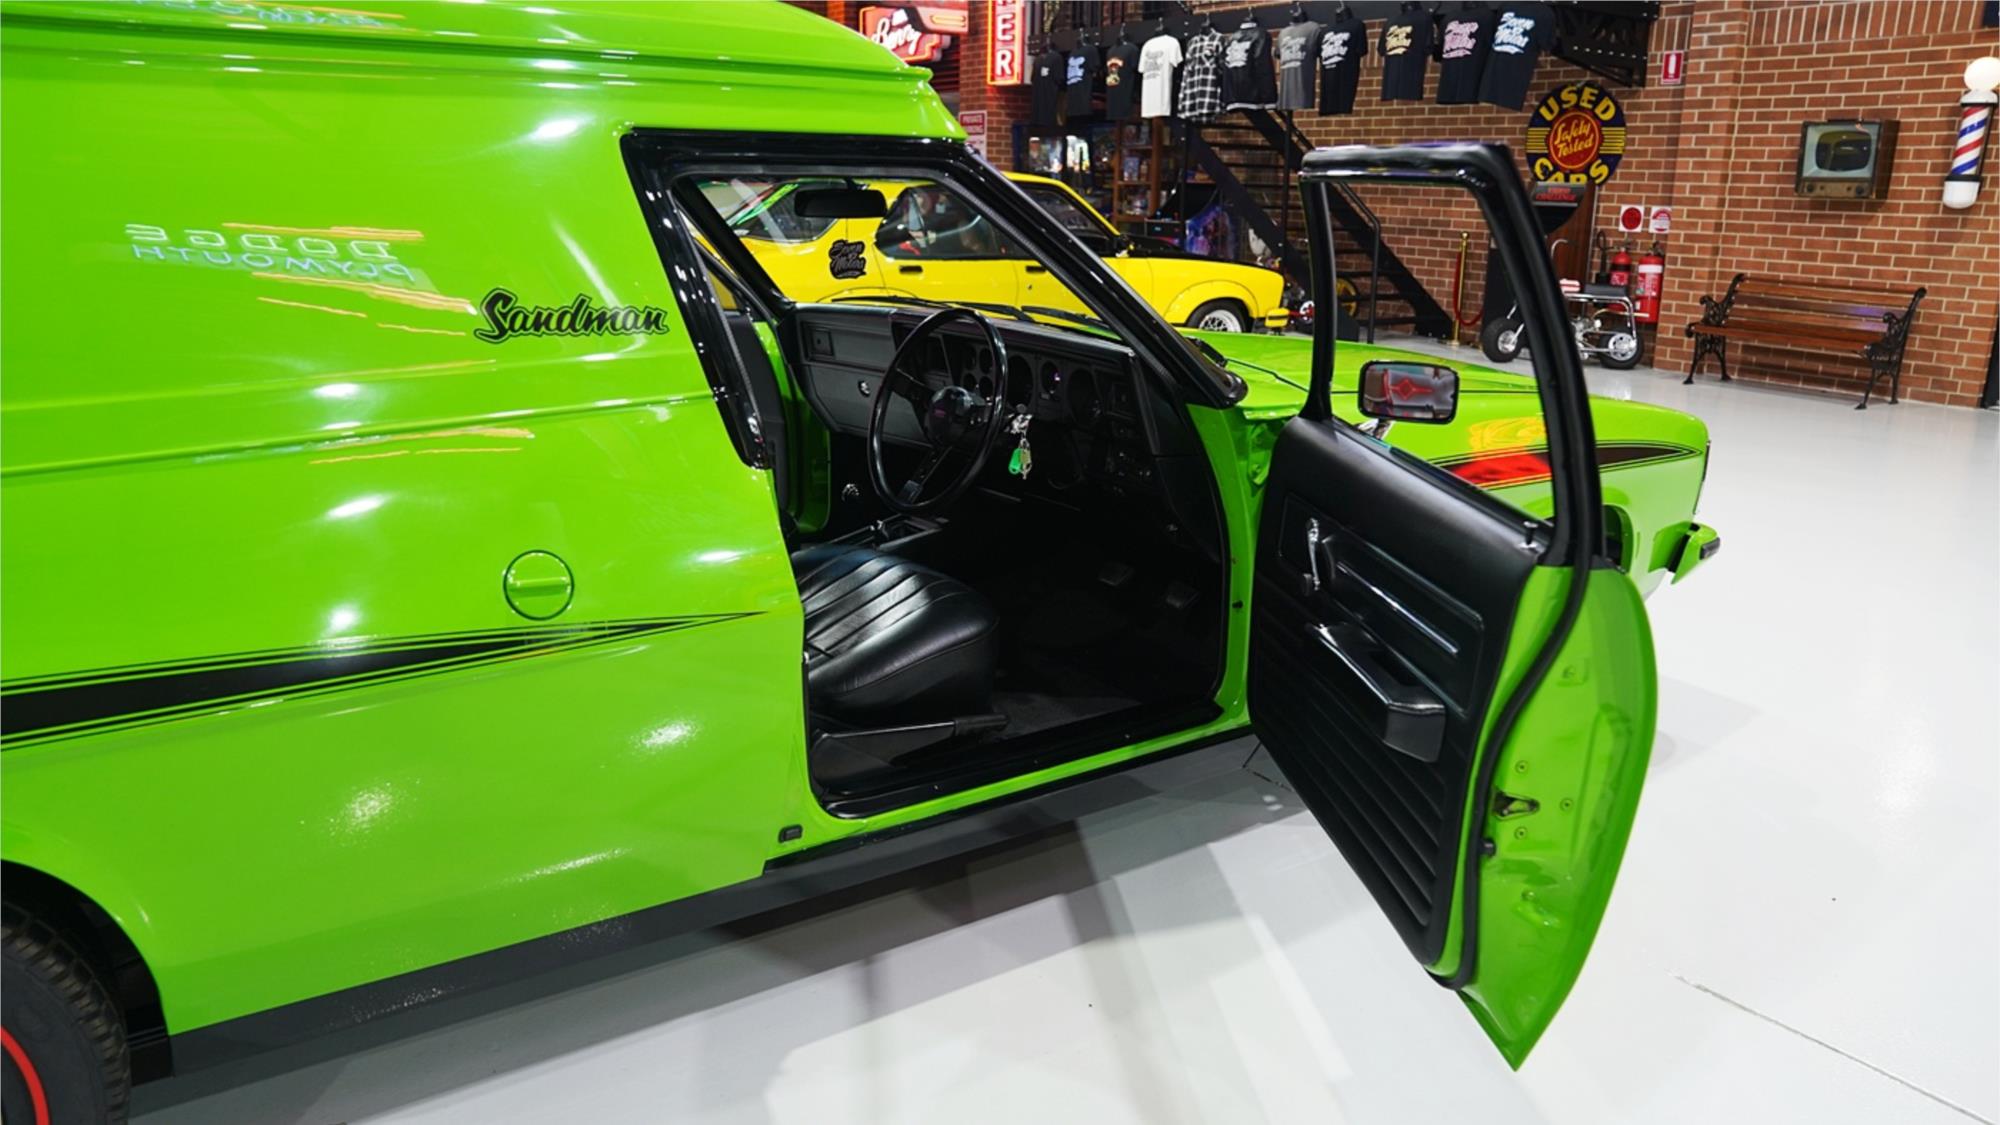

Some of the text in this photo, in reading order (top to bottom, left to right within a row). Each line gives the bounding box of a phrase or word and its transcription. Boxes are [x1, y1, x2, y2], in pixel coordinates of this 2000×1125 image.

[1539, 86, 1616, 121] USED
[1554, 120, 1591, 145] Safety
[1557, 134, 1595, 158] Tested
[474, 287, 669, 343] Sandman
